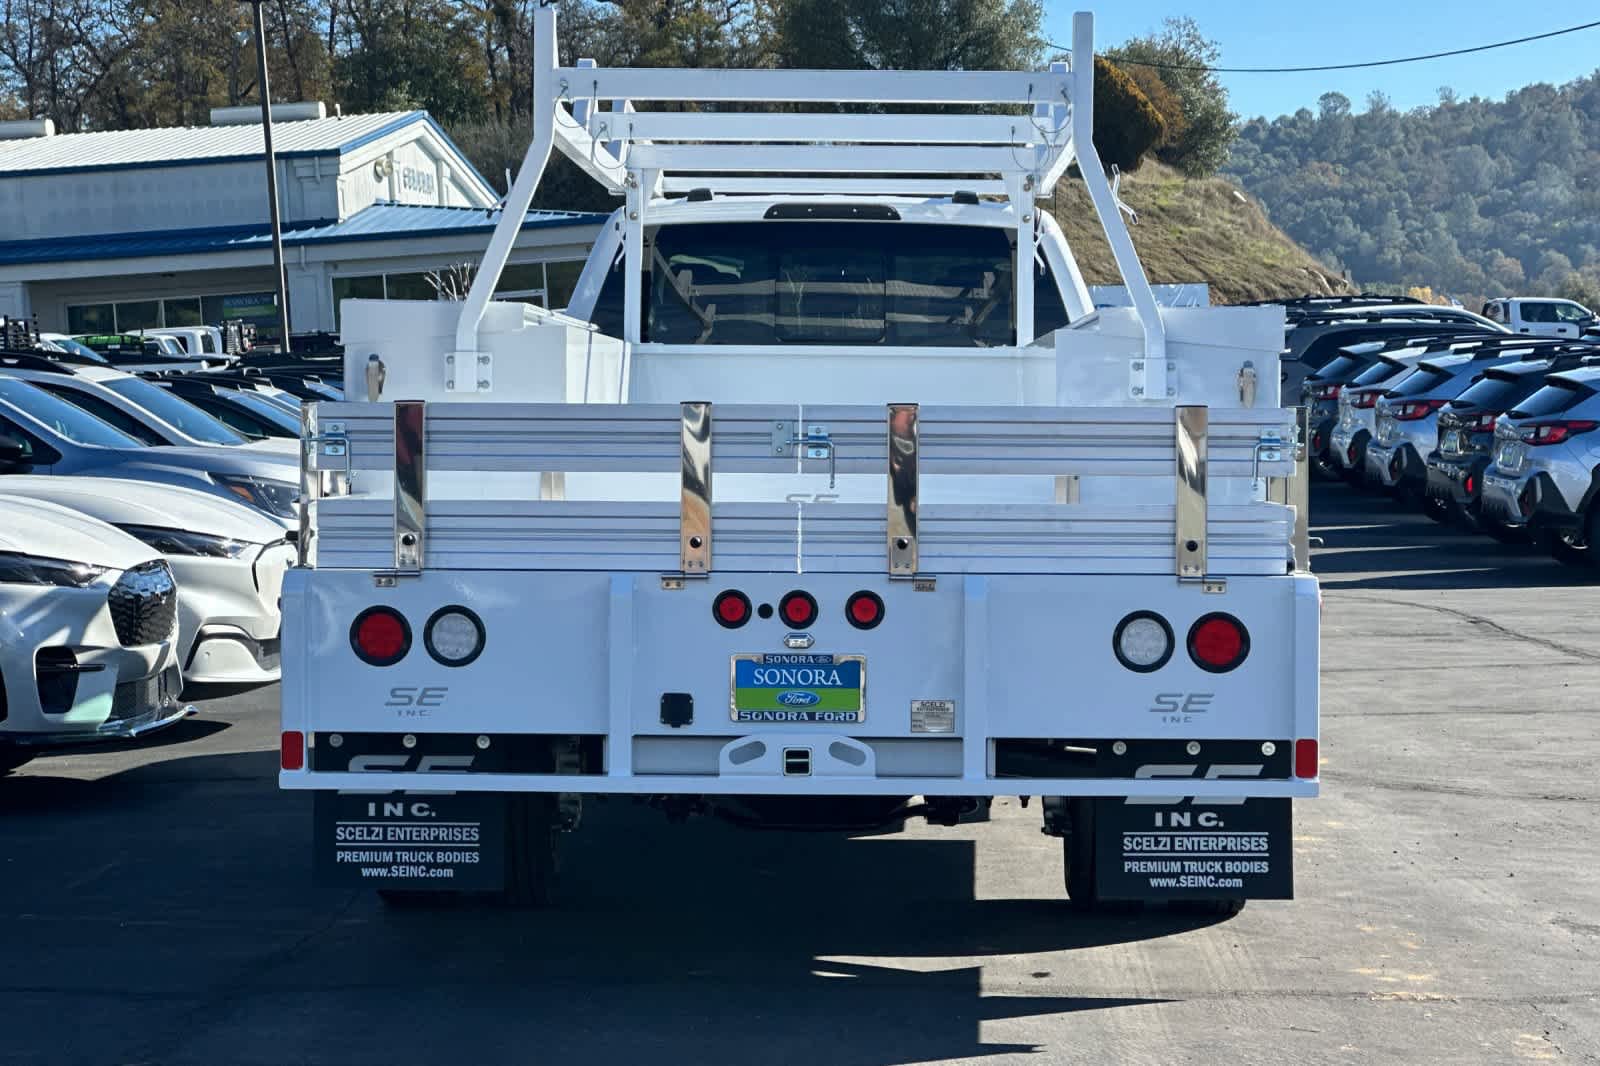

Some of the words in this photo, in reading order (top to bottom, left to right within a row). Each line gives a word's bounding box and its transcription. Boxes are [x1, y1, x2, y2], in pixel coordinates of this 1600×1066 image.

[765, 655, 815, 664] SONORA
[753, 668, 843, 686] SONORA
[384, 687, 449, 706] SE
[784, 692, 812, 704] Ford
[1148, 693, 1215, 712] SE
[739, 711, 809, 721] SONORA
[815, 711, 857, 721] FORD
[368, 802, 436, 817] INC.
[1155, 811, 1225, 827] INC.
[335, 826, 383, 841] SCELZI
[387, 827, 480, 841] ENTERPRISES
[1123, 836, 1171, 851] SCELZI
[1174, 837, 1269, 851] ENTERPRISES
[336, 851, 393, 863] PREMIUM
[396, 851, 434, 863] TRUCK
[436, 851, 480, 863] BODIES
[361, 865, 454, 878] www.SEINC.com
[1124, 861, 1181, 873] PREMIUM
[1183, 861, 1223, 873] TRUCK
[1225, 861, 1270, 873] BODIES
[1149, 875, 1243, 888] www.SEINC.com
